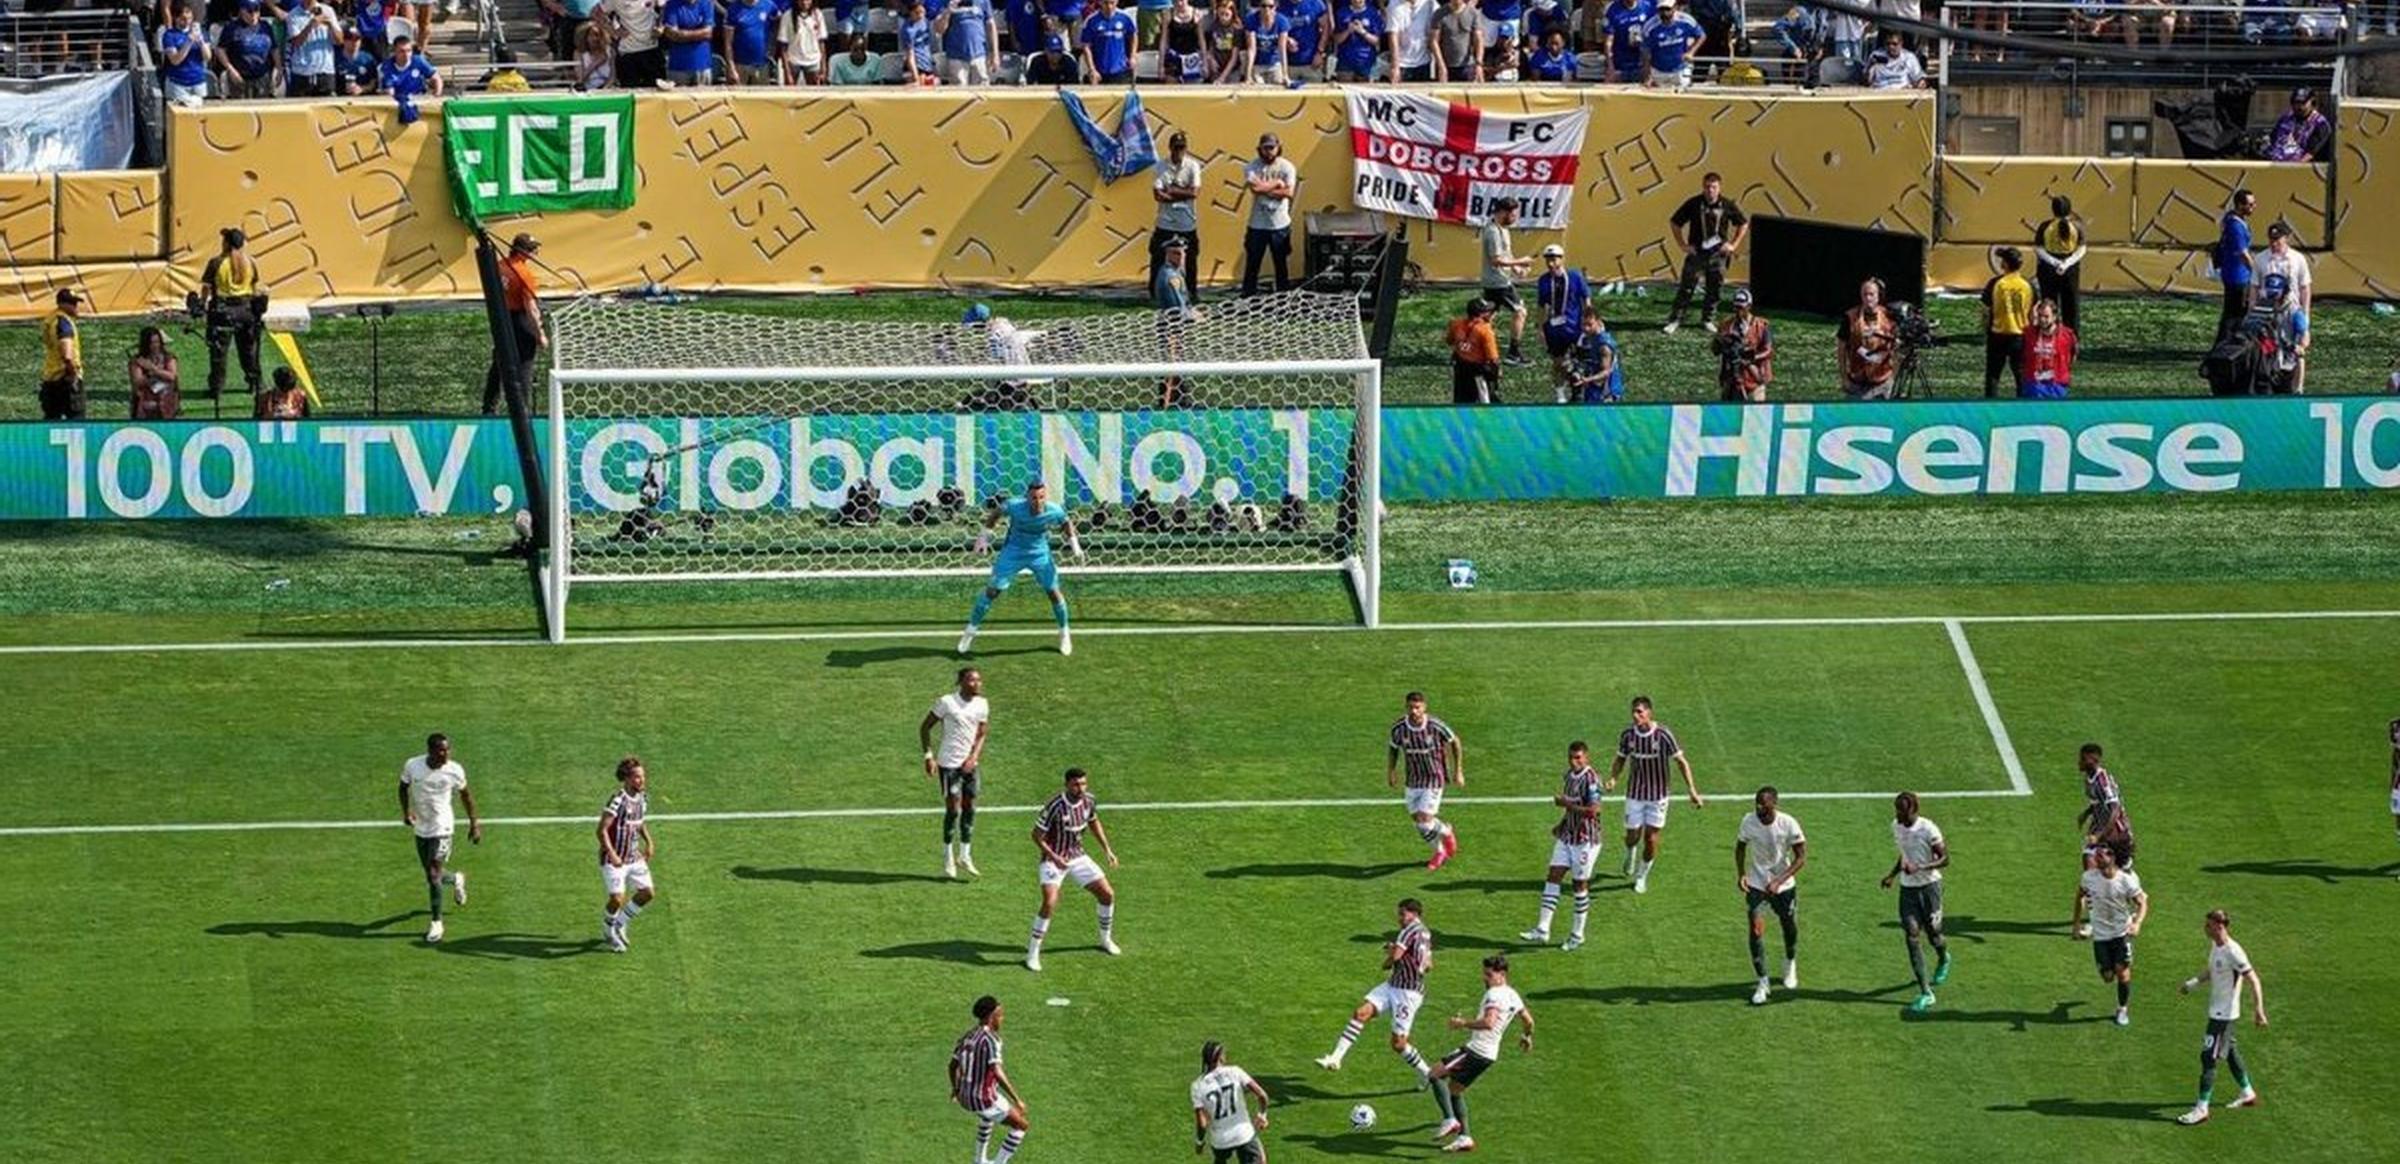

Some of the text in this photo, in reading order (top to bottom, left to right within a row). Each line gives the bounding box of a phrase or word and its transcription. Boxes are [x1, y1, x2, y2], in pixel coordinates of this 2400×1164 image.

[1508, 121, 1554, 143] FC
[1368, 134, 1553, 182] DOBCROSS
[1357, 174, 1419, 206] PRIDE
[1470, 195, 1553, 218] BATLE
[319, 426, 512, 515] TV,
[581, 411, 976, 510] Global
[1039, 411, 1240, 504] No.
[1273, 409, 1309, 500] 1
[1664, 403, 2245, 496] Hisense
[1206, 1082, 1236, 1119] 27
